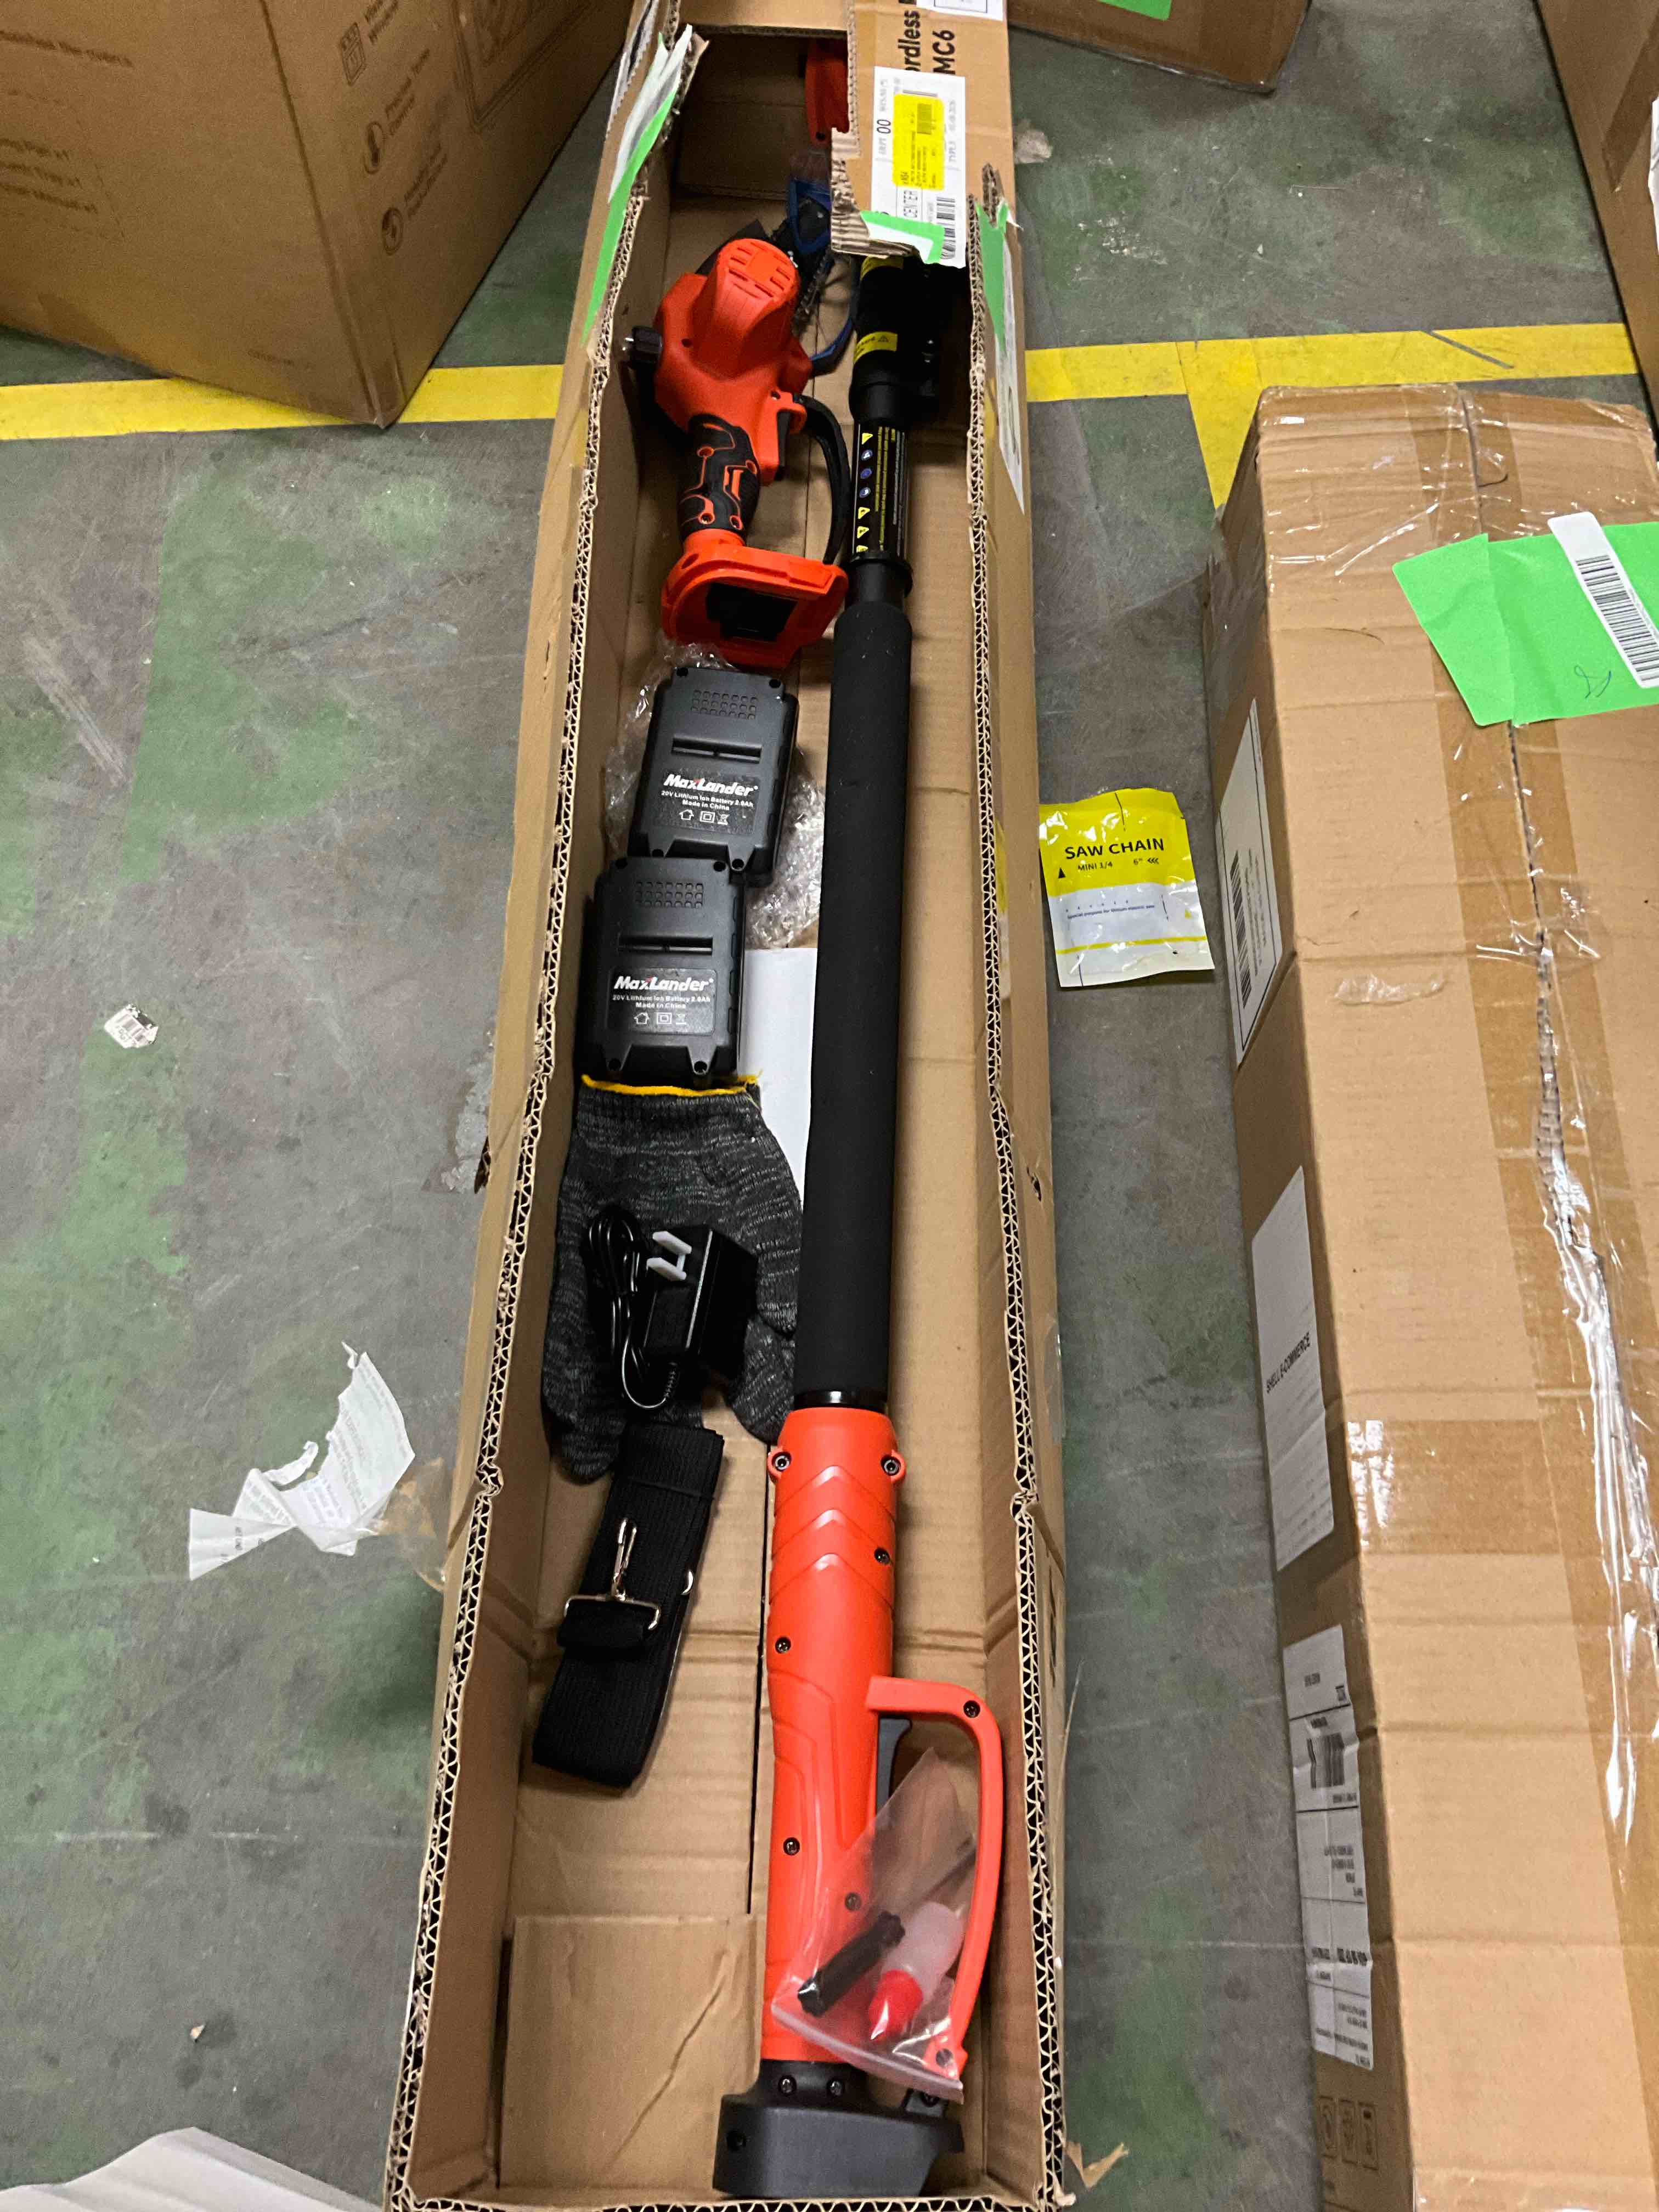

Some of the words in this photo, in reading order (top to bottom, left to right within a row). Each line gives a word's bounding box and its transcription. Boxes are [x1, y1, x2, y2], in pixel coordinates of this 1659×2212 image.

[663, 774, 755, 797] MaxLander
[674, 792, 699, 800] Lithium
[710, 797, 734, 806] Battery
[709, 803, 730, 811] China
[1064, 845, 1103, 860] SAW
[1108, 838, 1165, 854] CHAIN
[1077, 862, 1098, 871] MINI
[614, 975, 709, 991] MaxLander
